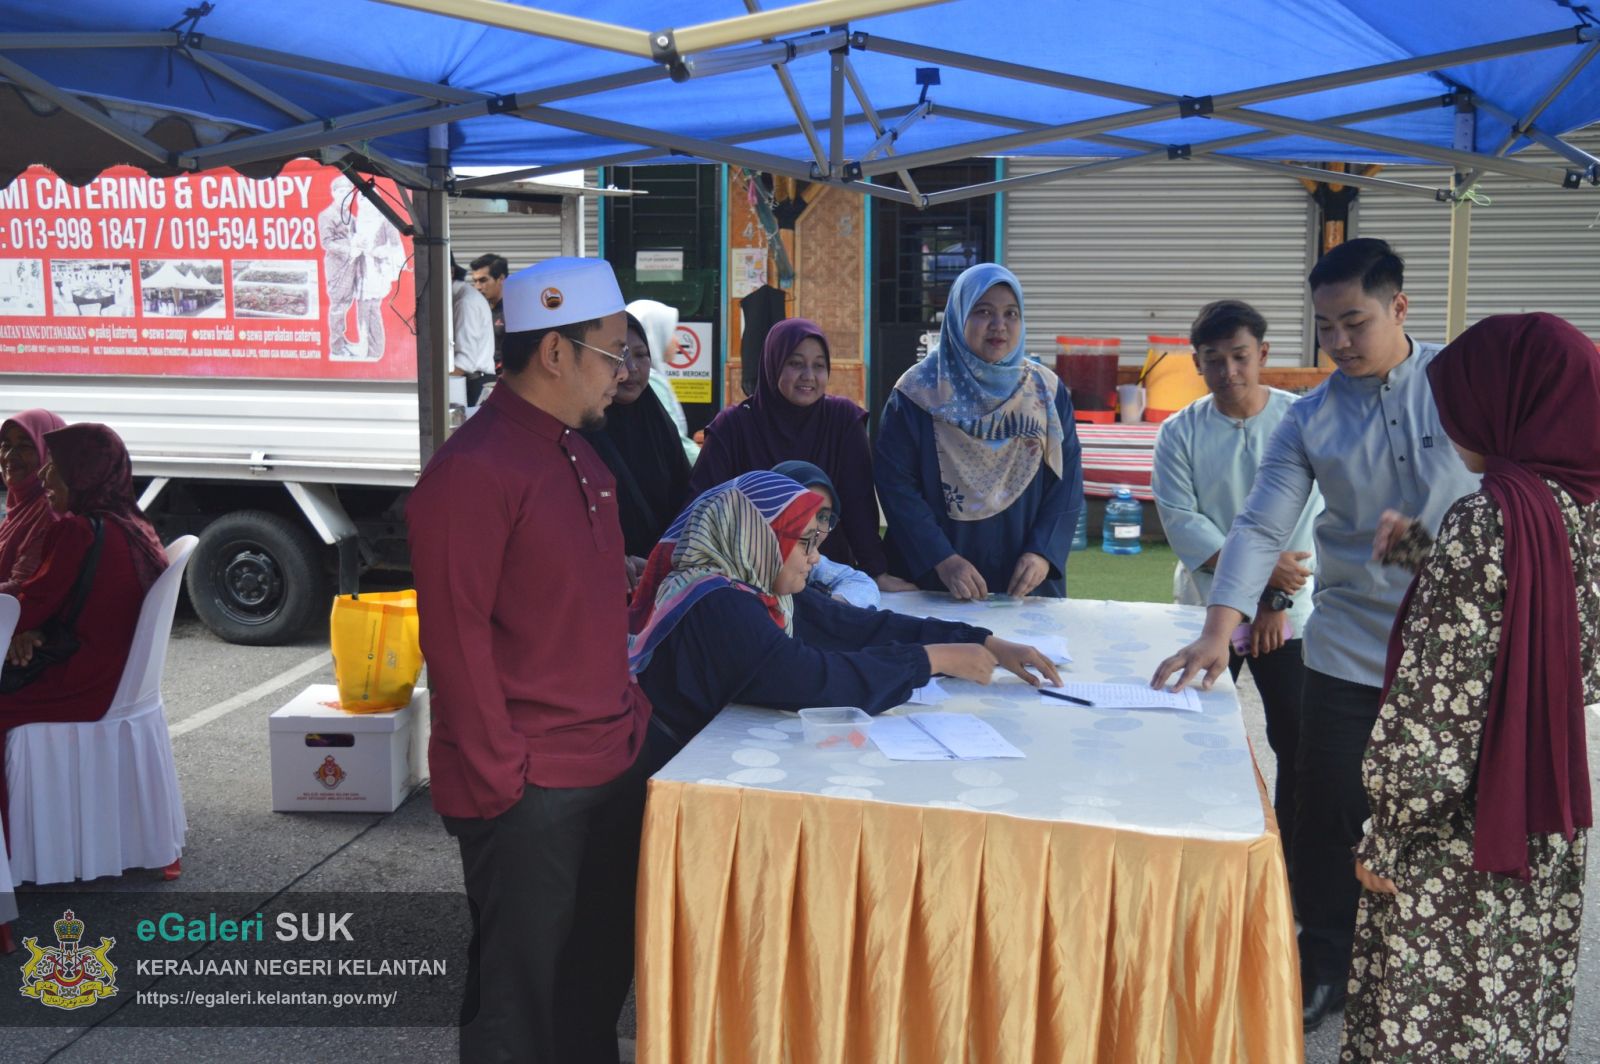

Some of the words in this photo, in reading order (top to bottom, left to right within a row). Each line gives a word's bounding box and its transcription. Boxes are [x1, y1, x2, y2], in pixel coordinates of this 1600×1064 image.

[36, 177, 166, 209] CATERING
[174, 177, 192, 209] &
[201, 176, 312, 209] CANOPY
[10, 217, 93, 249] 013-998
[98, 217, 147, 249] 1847
[154, 217, 164, 249] /
[170, 217, 258, 249] 019-594
[263, 217, 316, 250] 5028
